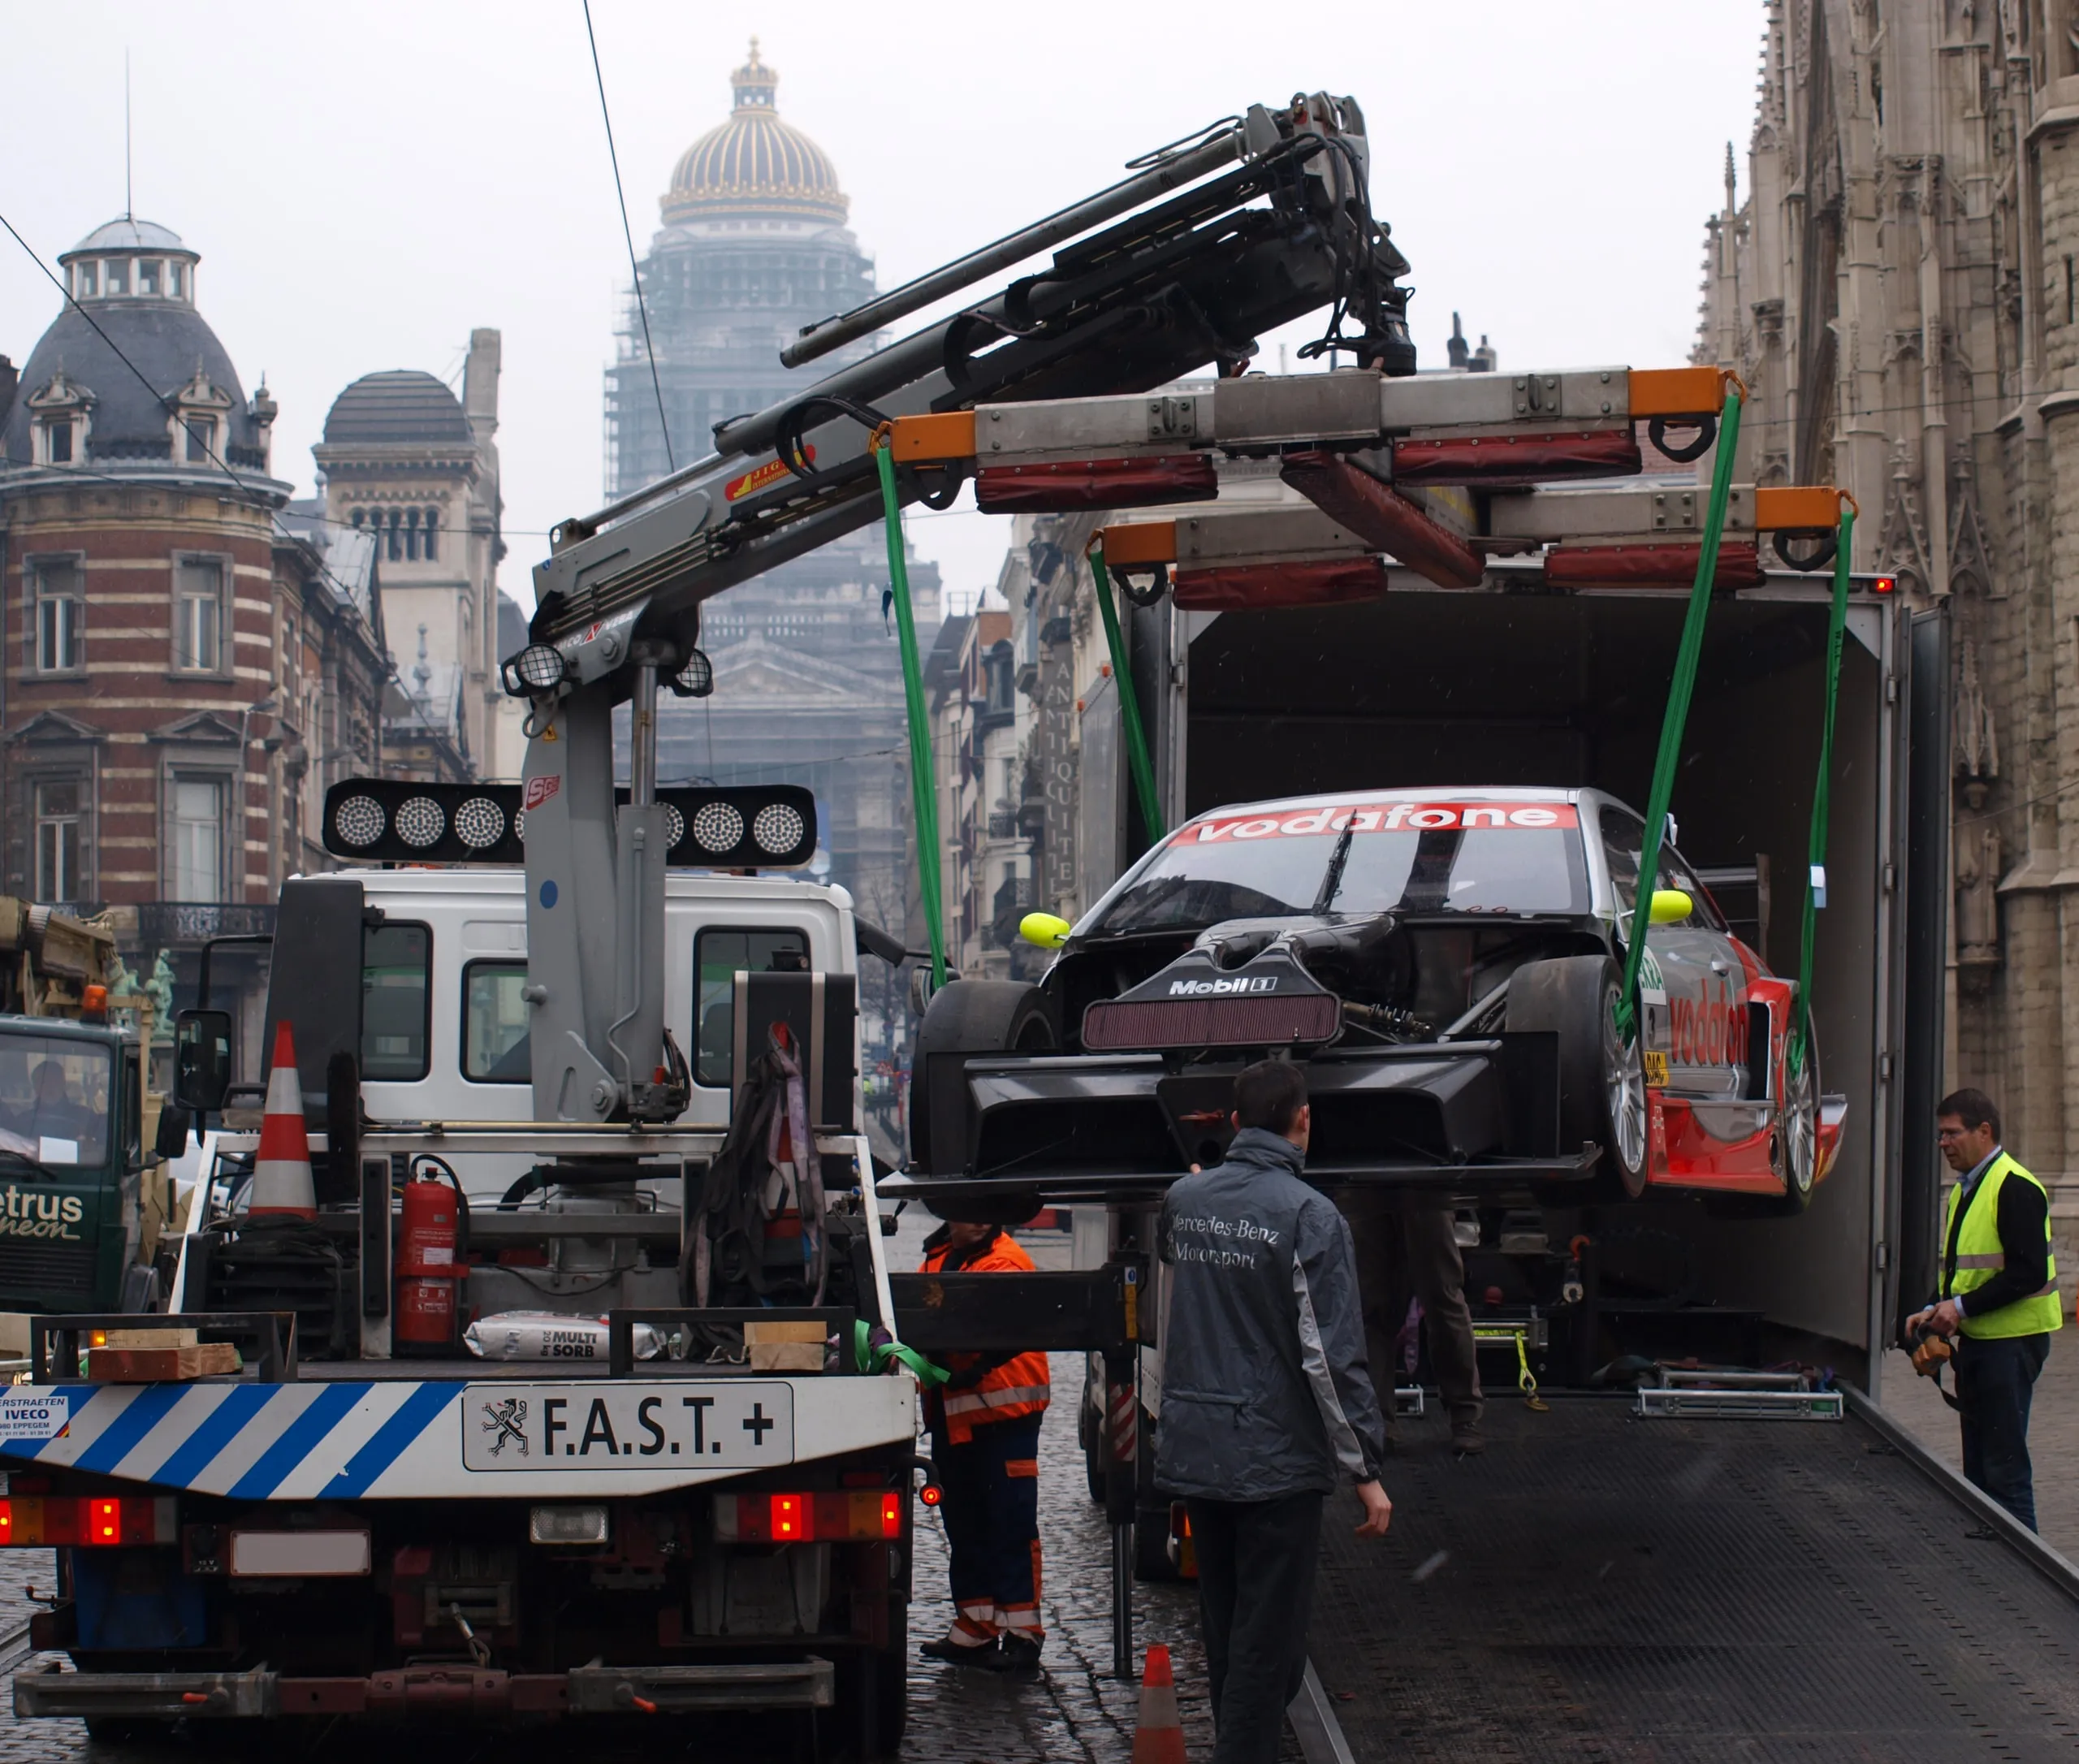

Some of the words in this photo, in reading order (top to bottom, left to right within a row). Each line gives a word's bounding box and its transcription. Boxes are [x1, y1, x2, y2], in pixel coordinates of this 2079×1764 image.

[753, 460, 785, 480] JIG
[1198, 803, 1558, 842] vodafone
[1169, 977, 1249, 996] Mobil
[0, 1184, 83, 1223] trus
[1175, 1242, 1258, 1270] Motorsport
[552, 1331, 598, 1345] MULTI
[552, 1344, 594, 1358] SORB
[5, 1408, 50, 1420] IVECO
[13, 1421, 50, 1429] EPPEGEM
[544, 1396, 721, 1456] F.A.S.T.
